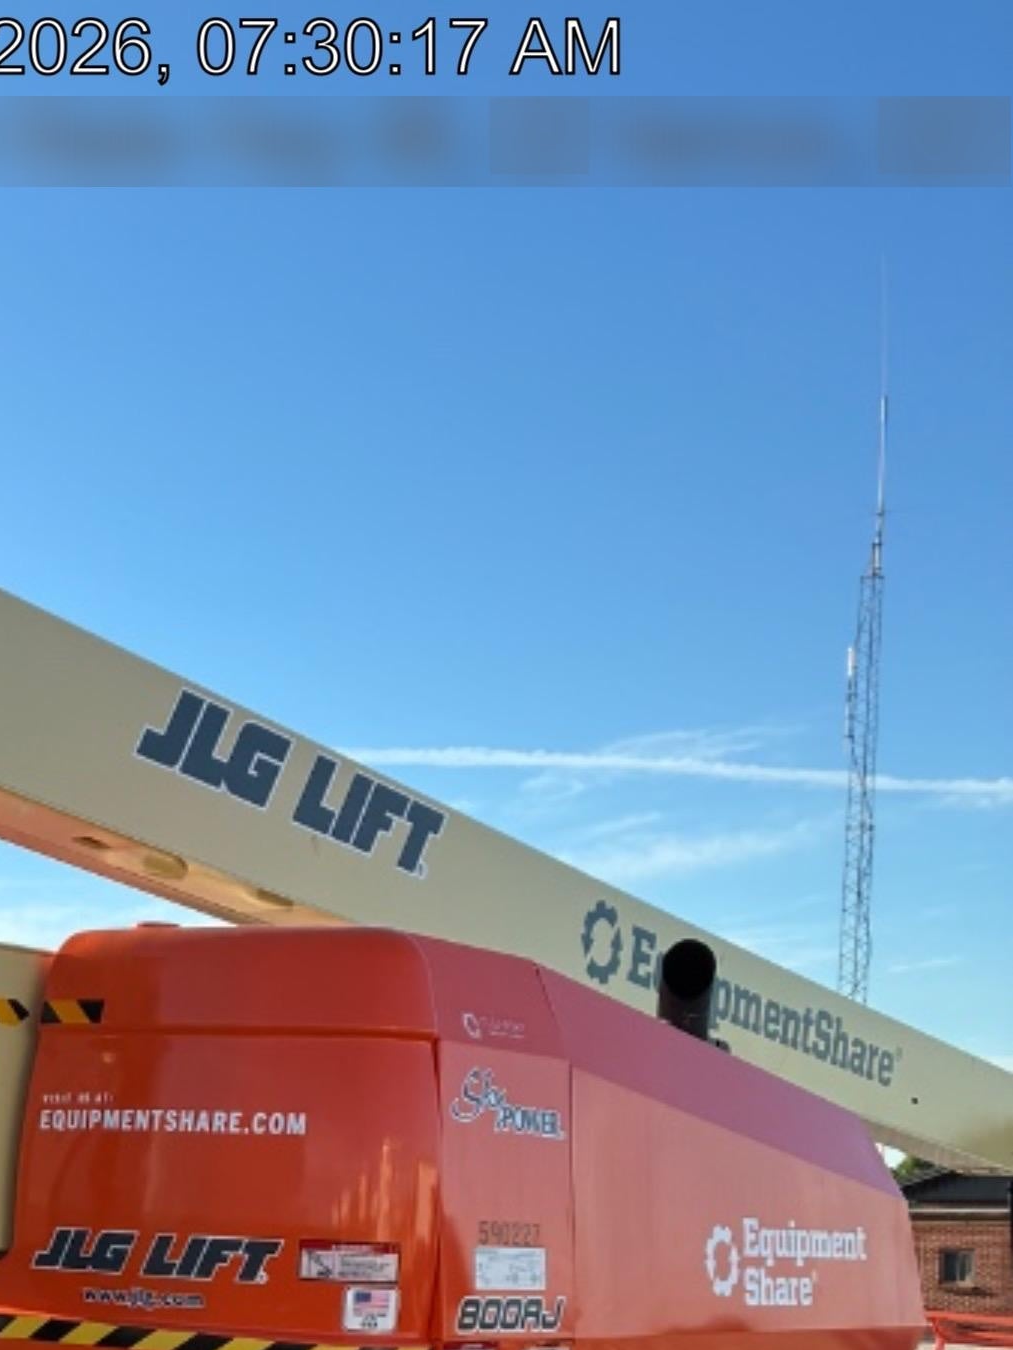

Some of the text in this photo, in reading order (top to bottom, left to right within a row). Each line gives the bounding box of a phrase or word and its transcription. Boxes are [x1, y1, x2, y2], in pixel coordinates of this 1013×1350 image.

[135, 686, 449, 877] JLG LIFT
[39, 1108, 308, 1136] EQUIPMENTSHARE.COM
[31, 1226, 139, 1276] JLG
[139, 1232, 285, 1285] LIFT
[742, 1217, 867, 1267] Equipment
[743, 1266, 814, 1306] Share
[456, 1295, 567, 1335] 800AJ
